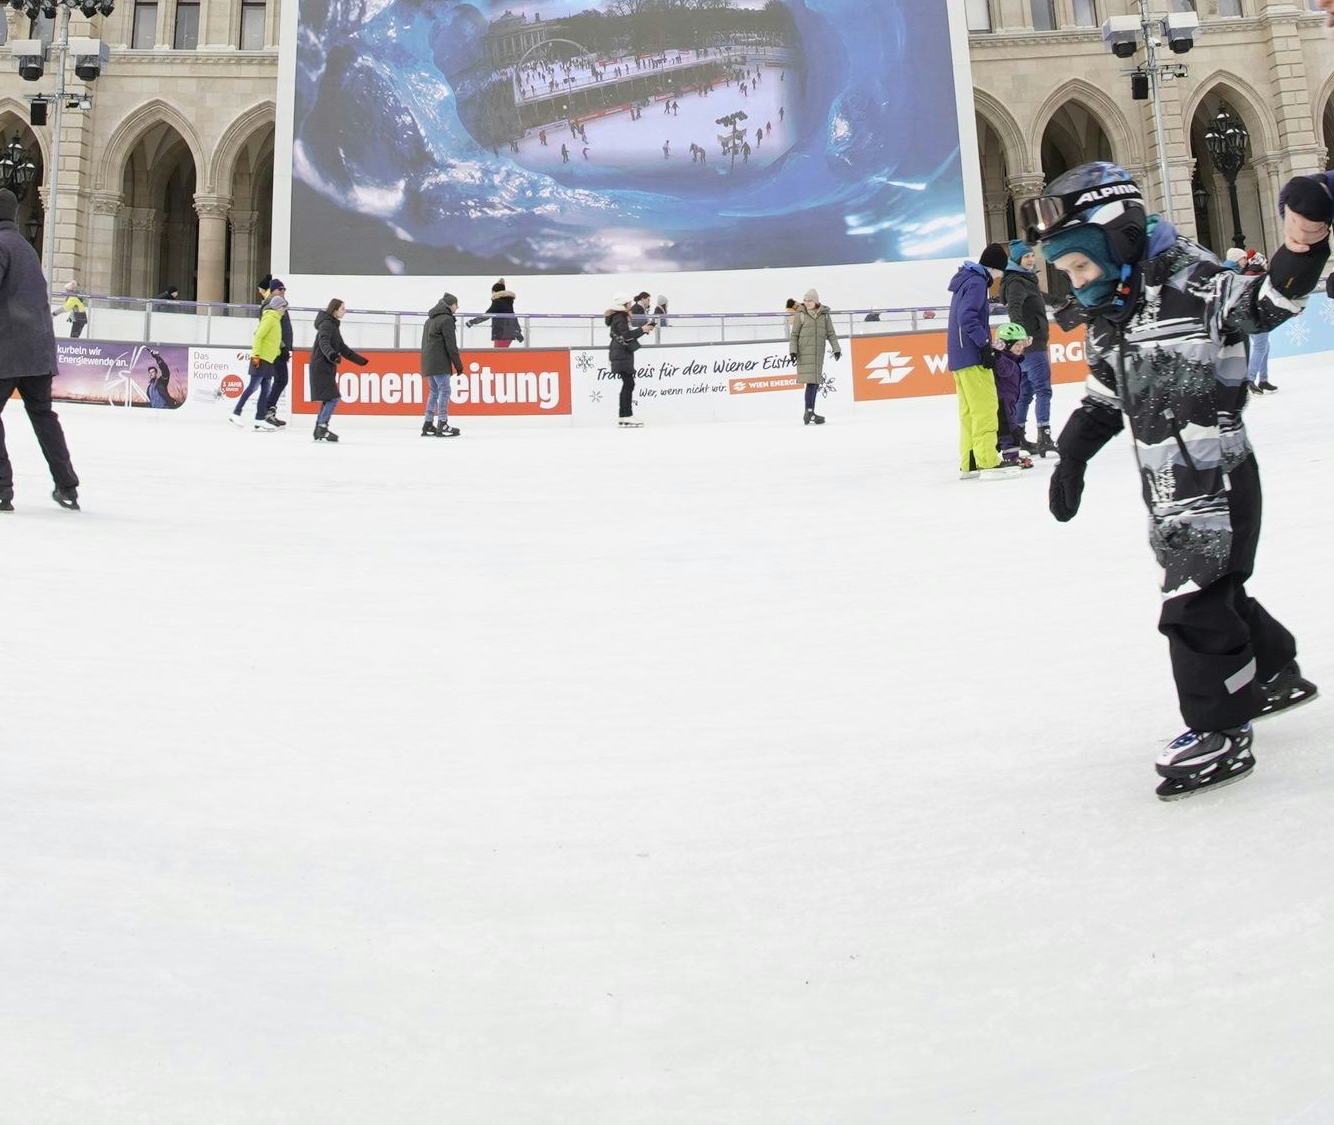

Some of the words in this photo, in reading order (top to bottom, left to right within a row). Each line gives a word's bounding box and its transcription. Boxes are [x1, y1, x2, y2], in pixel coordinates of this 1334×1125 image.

[1074, 184, 1141, 206] ALPINA
[57, 345, 87, 356] kurbeln
[88, 347, 102, 356] wir
[193, 351, 210, 360] Das
[193, 361, 229, 371] GoGreen
[659, 362, 679, 381] für
[683, 359, 707, 375] den
[712, 356, 759, 374] Wiener
[450, 362, 560, 410] eitung
[748, 380, 769, 388] WIEN
[769, 378, 798, 387] ENERGI
[639, 387, 658, 398] Wer,
[660, 387, 685, 396] wenn
[686, 383, 710, 395] nicht
[711, 383, 727, 393] wir.
